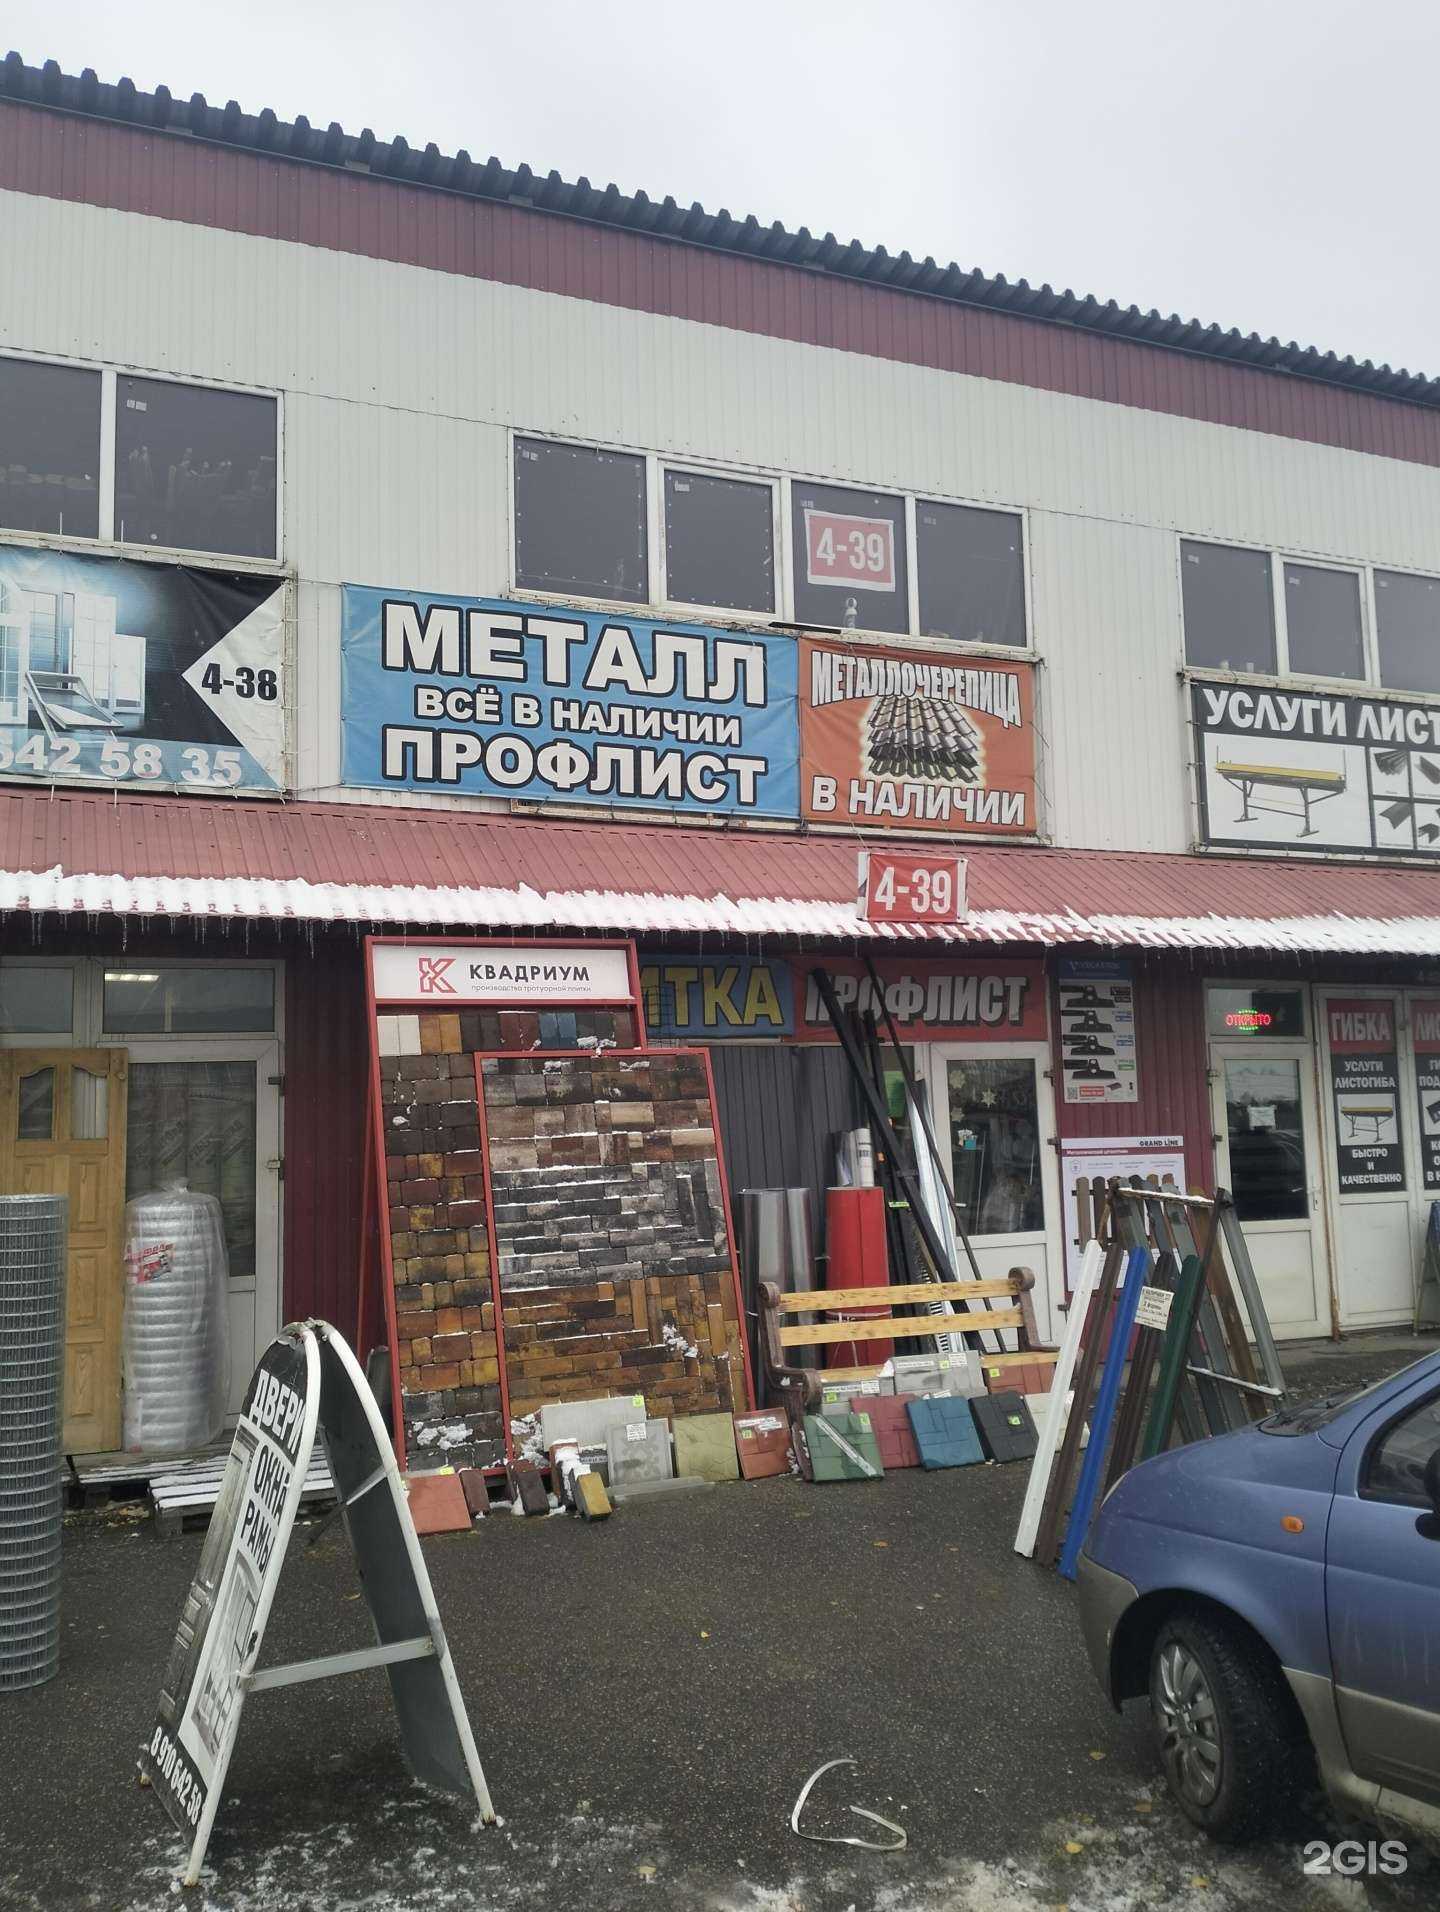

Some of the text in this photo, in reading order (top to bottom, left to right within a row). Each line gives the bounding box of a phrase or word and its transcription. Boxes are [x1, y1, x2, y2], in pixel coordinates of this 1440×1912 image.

[815, 527, 885, 574] 4-39
[382, 599, 768, 708] МЕТАЛЛ
[201, 662, 278, 701] 4-38
[811, 650, 1022, 729] МЕТАЛЛОЧЕРЕПИЦА
[415, 685, 742, 747] ВСЁ В НАЛИЧИИ
[1203, 688, 1347, 736] УСЛУГИ
[100, 735, 163, 779] 58
[180, 748, 242, 785] 35
[382, 724, 768, 805] ПРОФЛИСТ
[811, 775, 1025, 827] В НАЛИЧИИ
[874, 867, 952, 915] 4-39
[469, 963, 590, 983] КВАДРИУМ
[1226, 1014, 1271, 1026] ОТКРЫТО
[1331, 1012, 1391, 1041] ГИБКА
[1335, 1077, 1396, 1089] ЛИСТОГИБА
[1344, 1060, 1384, 1072] УСЛУГИ
[1139, 1137, 1179, 1147] GRAND LINE
[1352, 1148, 1388, 1159] БЫСТРО
[1367, 1161, 1375, 1171] И
[1341, 1172, 1402, 1185] КАЧЕСТВЕННО
[248, 1368, 306, 1454] ДВЕРИ
[254, 1445, 290, 1527] ОКНА
[240, 1499, 276, 1580] РАМЫ
[150, 1725, 163, 1757] 8
[157, 1735, 177, 1780] 910
[170, 1758, 193, 1808] 642
